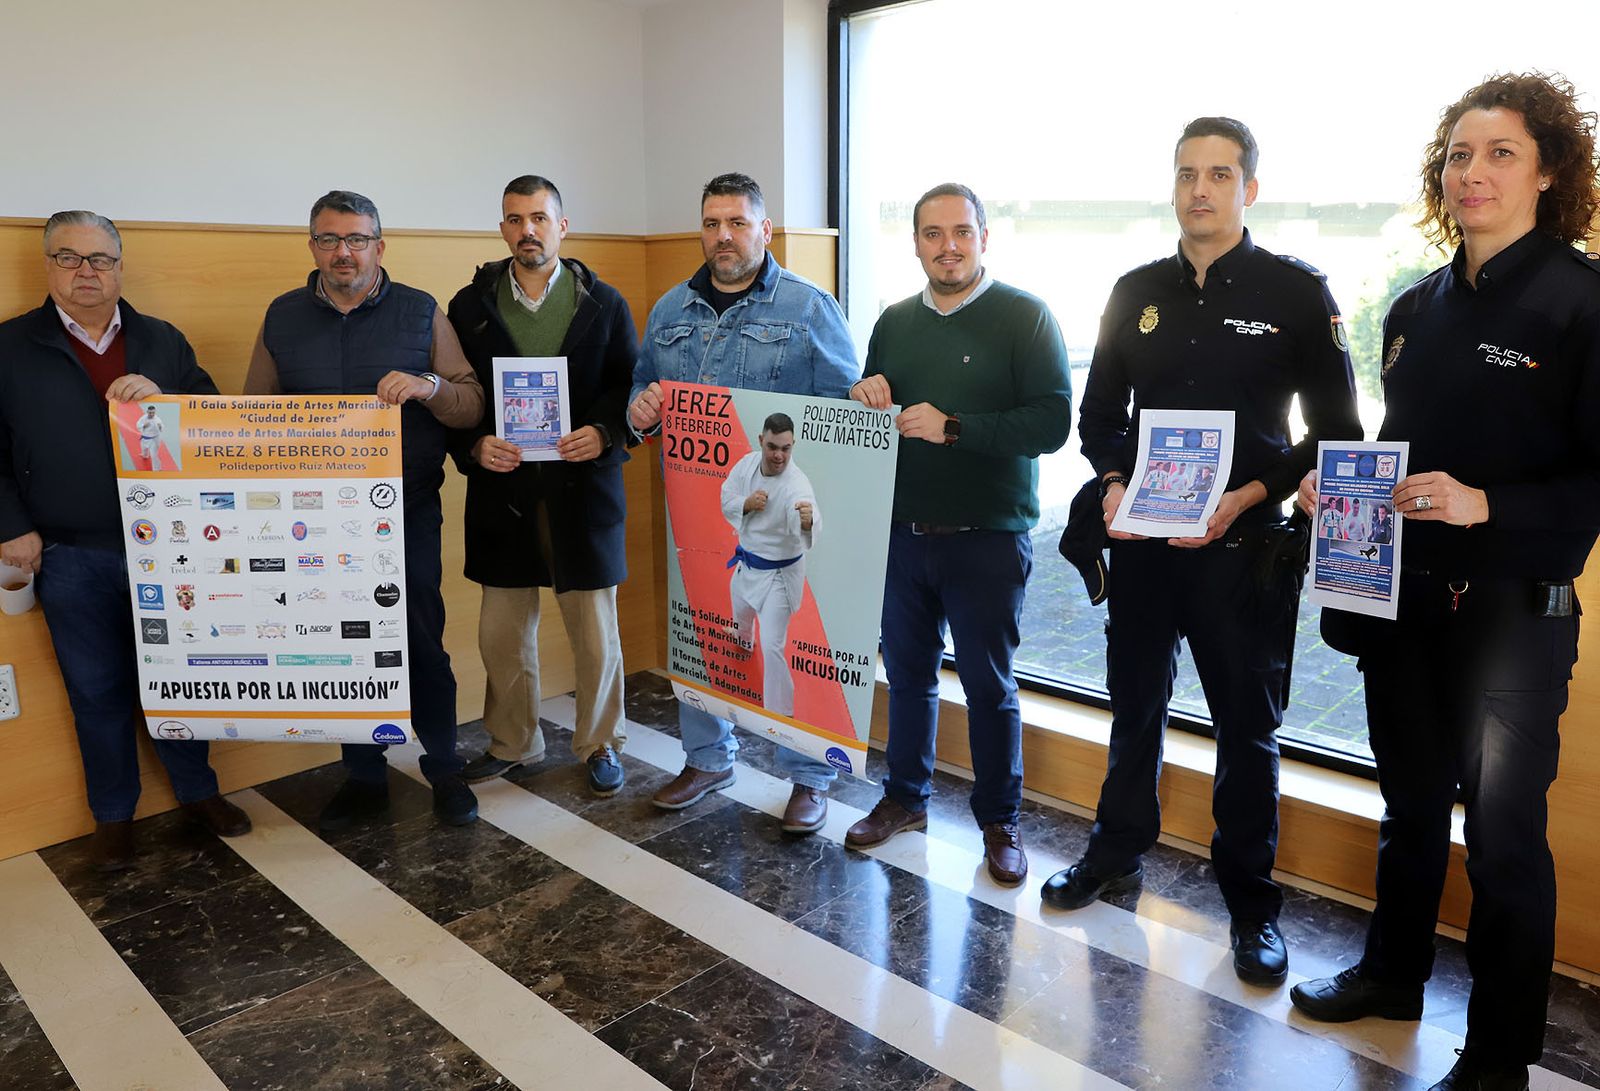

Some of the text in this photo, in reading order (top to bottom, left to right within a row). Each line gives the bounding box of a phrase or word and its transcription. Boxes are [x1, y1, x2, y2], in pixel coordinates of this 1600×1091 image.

[1224, 319, 1273, 331] POLICIA
[1236, 327, 1263, 335] CNP
[1477, 343, 1531, 365] POLICIA
[1485, 355, 1517, 368] CNP
[189, 400, 391, 410] II Gala Solidaria de Artes Marciales
[668, 388, 733, 419] JEREZ
[240, 414, 345, 423] "Ciudad de Jerez"
[666, 416, 732, 438] 8 FEBRERO
[804, 405, 892, 430] POLIDEPORTIVO
[188, 428, 396, 440] II Torneo de Artes Marciales Adaptadas
[801, 422, 891, 450] RUIZ MATEOS
[253, 445, 262, 457] 8
[268, 445, 345, 457] FEBRERO
[351, 446, 388, 457] 2020
[667, 434, 730, 467] 2020
[219, 461, 366, 472] Polideportivo Ruiz Mateos
[674, 463, 682, 472] DE
[684, 465, 693, 473] LA
[207, 526, 220, 538] A
[671, 600, 739, 630] II Gala Solidaria
[672, 615, 752, 649] de Artes Marciales
[672, 630, 705, 648] "Ciudad
[708, 639, 719, 651] de
[792, 640, 869, 666] "APUESTA POR LA
[672, 647, 747, 681] II Torneo de Artes
[148, 676, 399, 700] "APUESTA POR LA INCLUSIÓN"
[673, 662, 762, 701] Marciales Adaptadas
[374, 732, 404, 740] Cedown
[827, 754, 850, 769] Cedown
